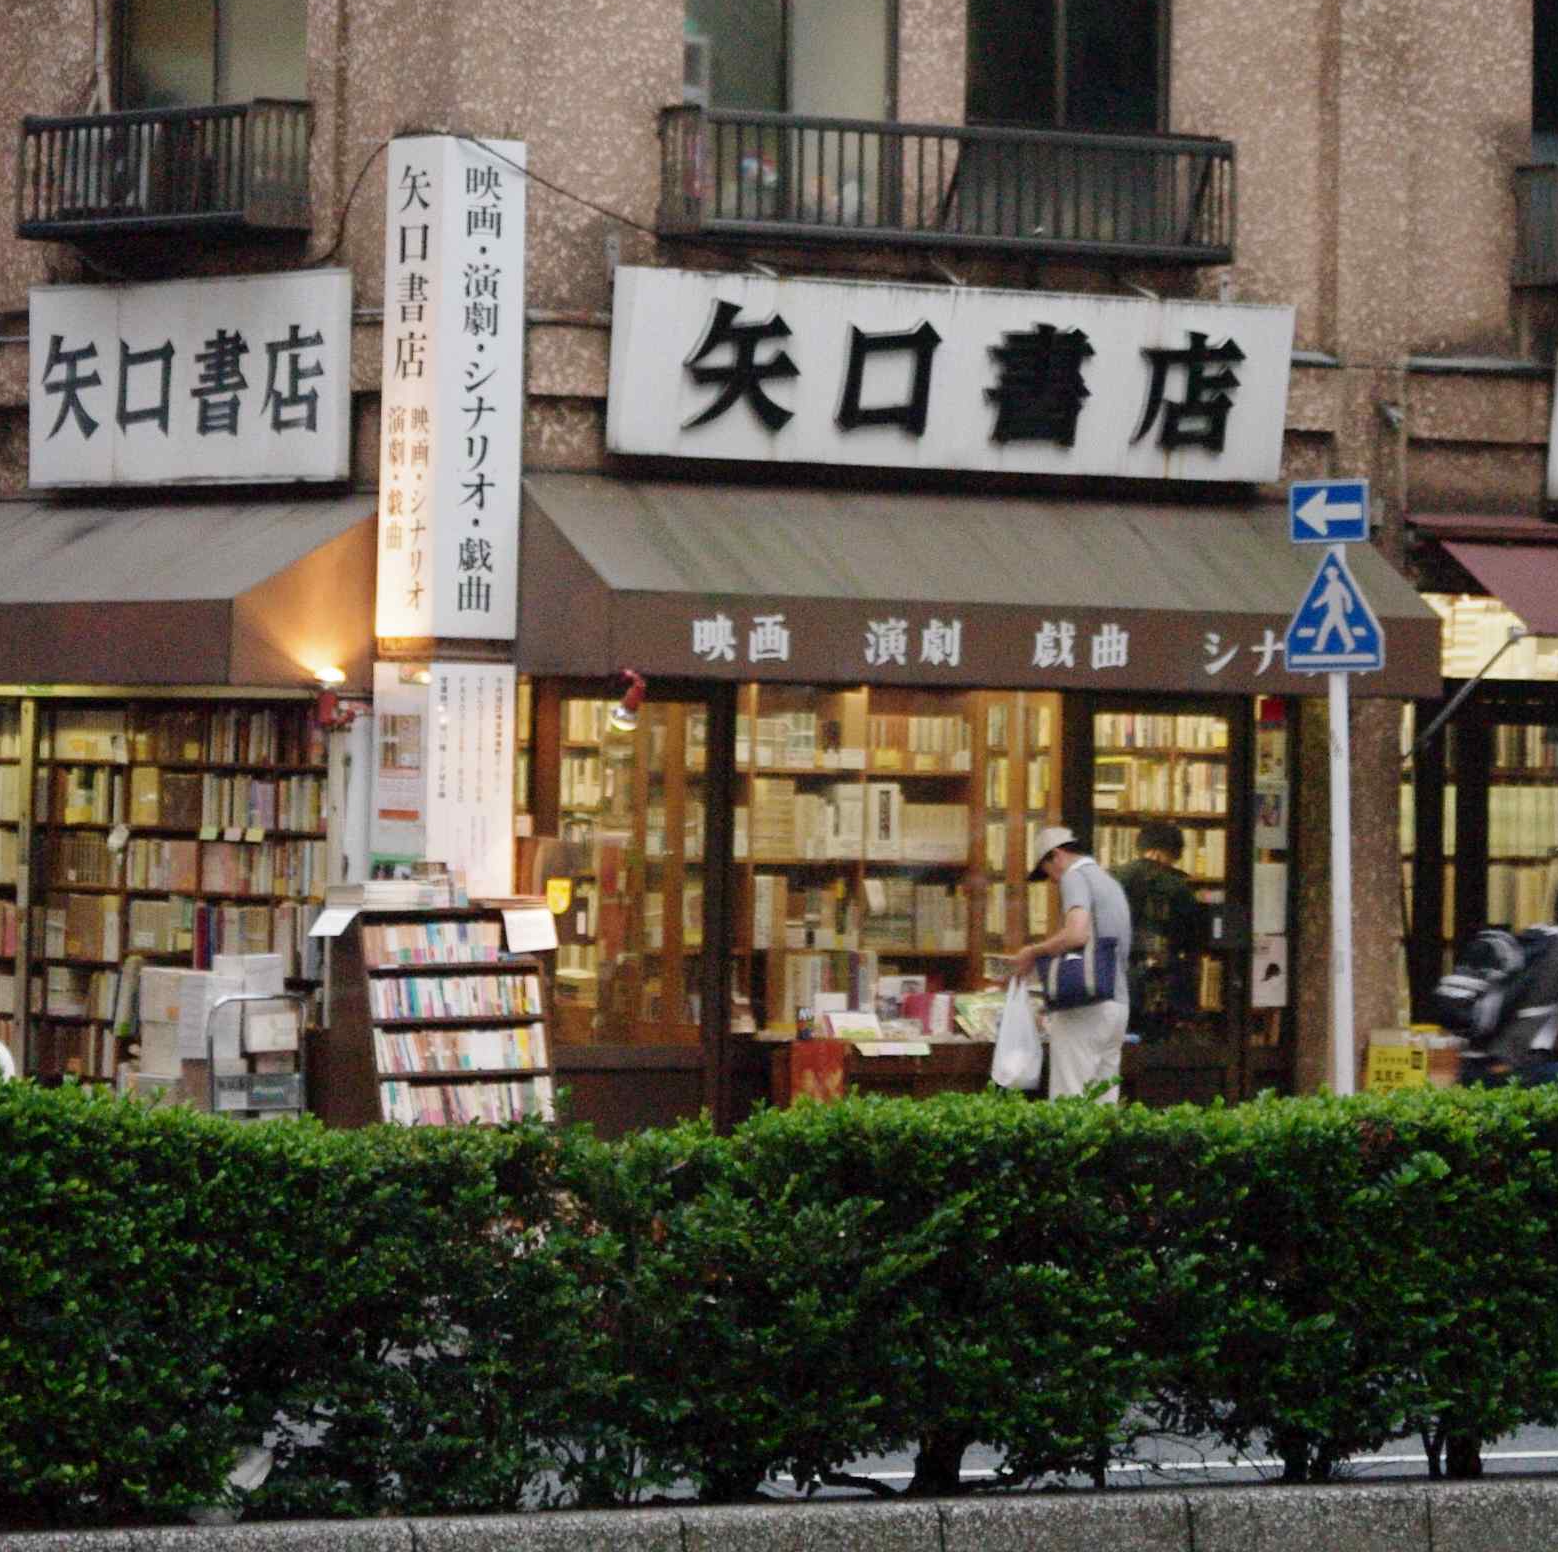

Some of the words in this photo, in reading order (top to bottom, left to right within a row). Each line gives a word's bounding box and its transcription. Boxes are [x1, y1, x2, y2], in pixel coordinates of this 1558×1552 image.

[394, 165, 431, 383] 矢口書店
[43, 324, 325, 443] 矢口書店
[681, 299, 1245, 453] 矢口書店
[692, 612, 792, 663] 映画
[864, 616, 963, 667] 演劇
[1032, 620, 1131, 671] 戯曲
